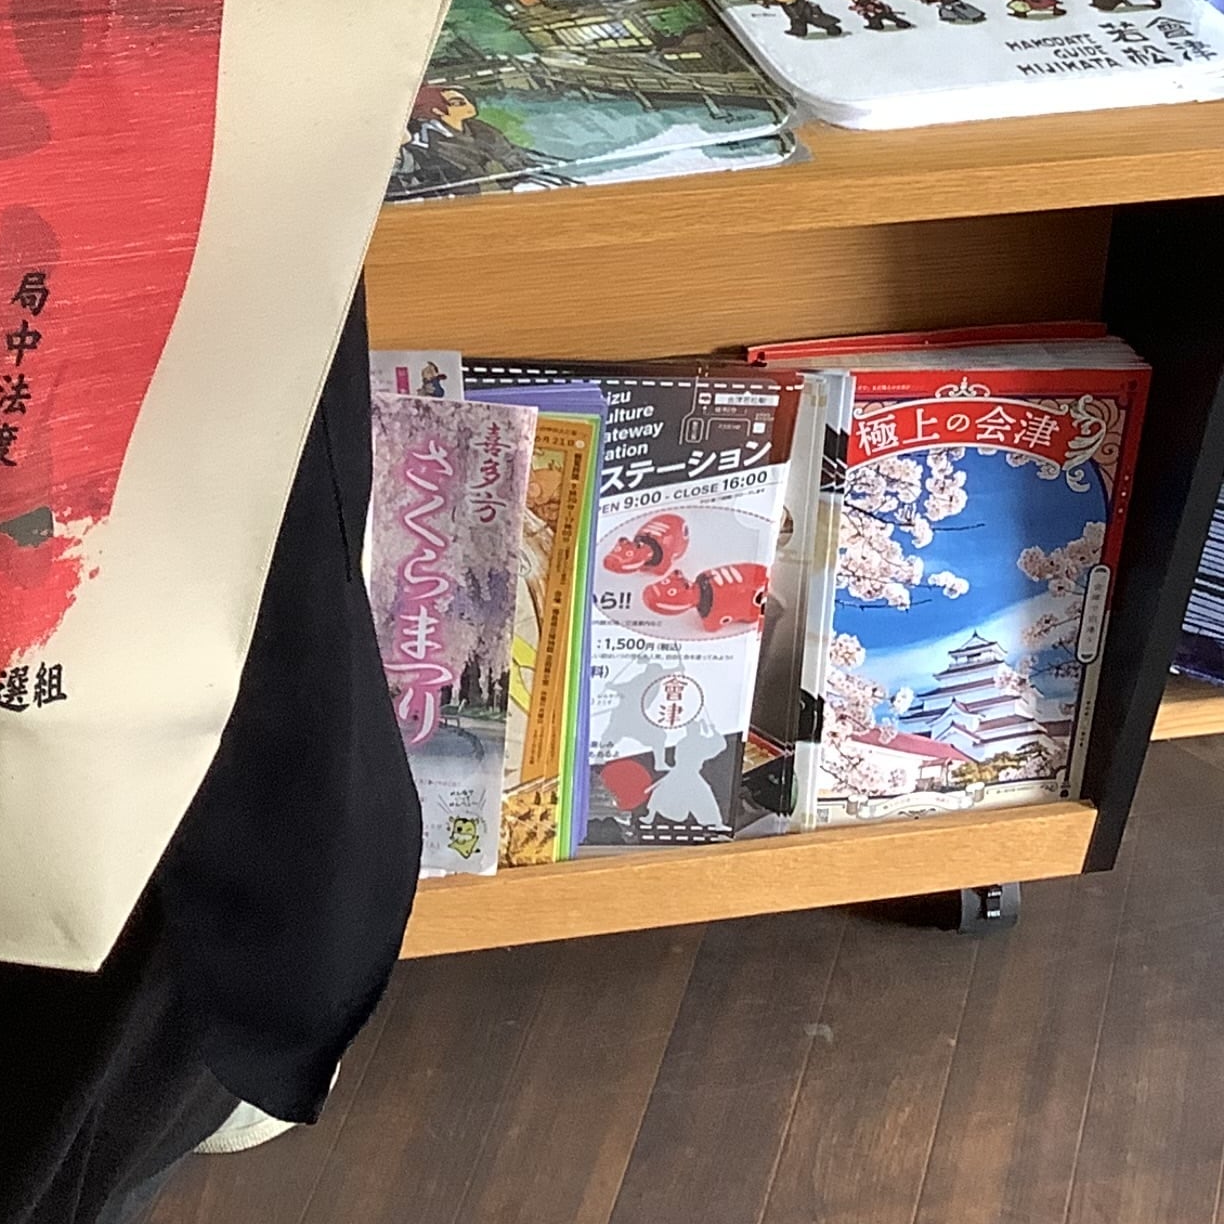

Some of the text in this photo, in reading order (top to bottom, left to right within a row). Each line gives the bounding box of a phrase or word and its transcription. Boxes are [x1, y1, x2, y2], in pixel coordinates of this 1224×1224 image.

[1005, 33, 1097, 53] HAKODATE
[1053, 44, 1109, 60] GUIDE
[1016, 57, 1124, 76] HIJIKATA
[606, 391, 632, 406] izu
[605, 405, 655, 425] ulture
[604, 422, 665, 443] ateway
[856, 405, 1061, 456] 極上の会津
[604, 442, 649, 462] ation
[470, 422, 514, 524] 喜多方
[600, 440, 773, 494] ステーション
[624, 491, 663, 509] 9:00
[673, 483, 719, 500] CLOSE
[722, 470, 768, 491] 16:00
[382, 439, 454, 745] さくらまつり
[657, 677, 689, 727] 會津
